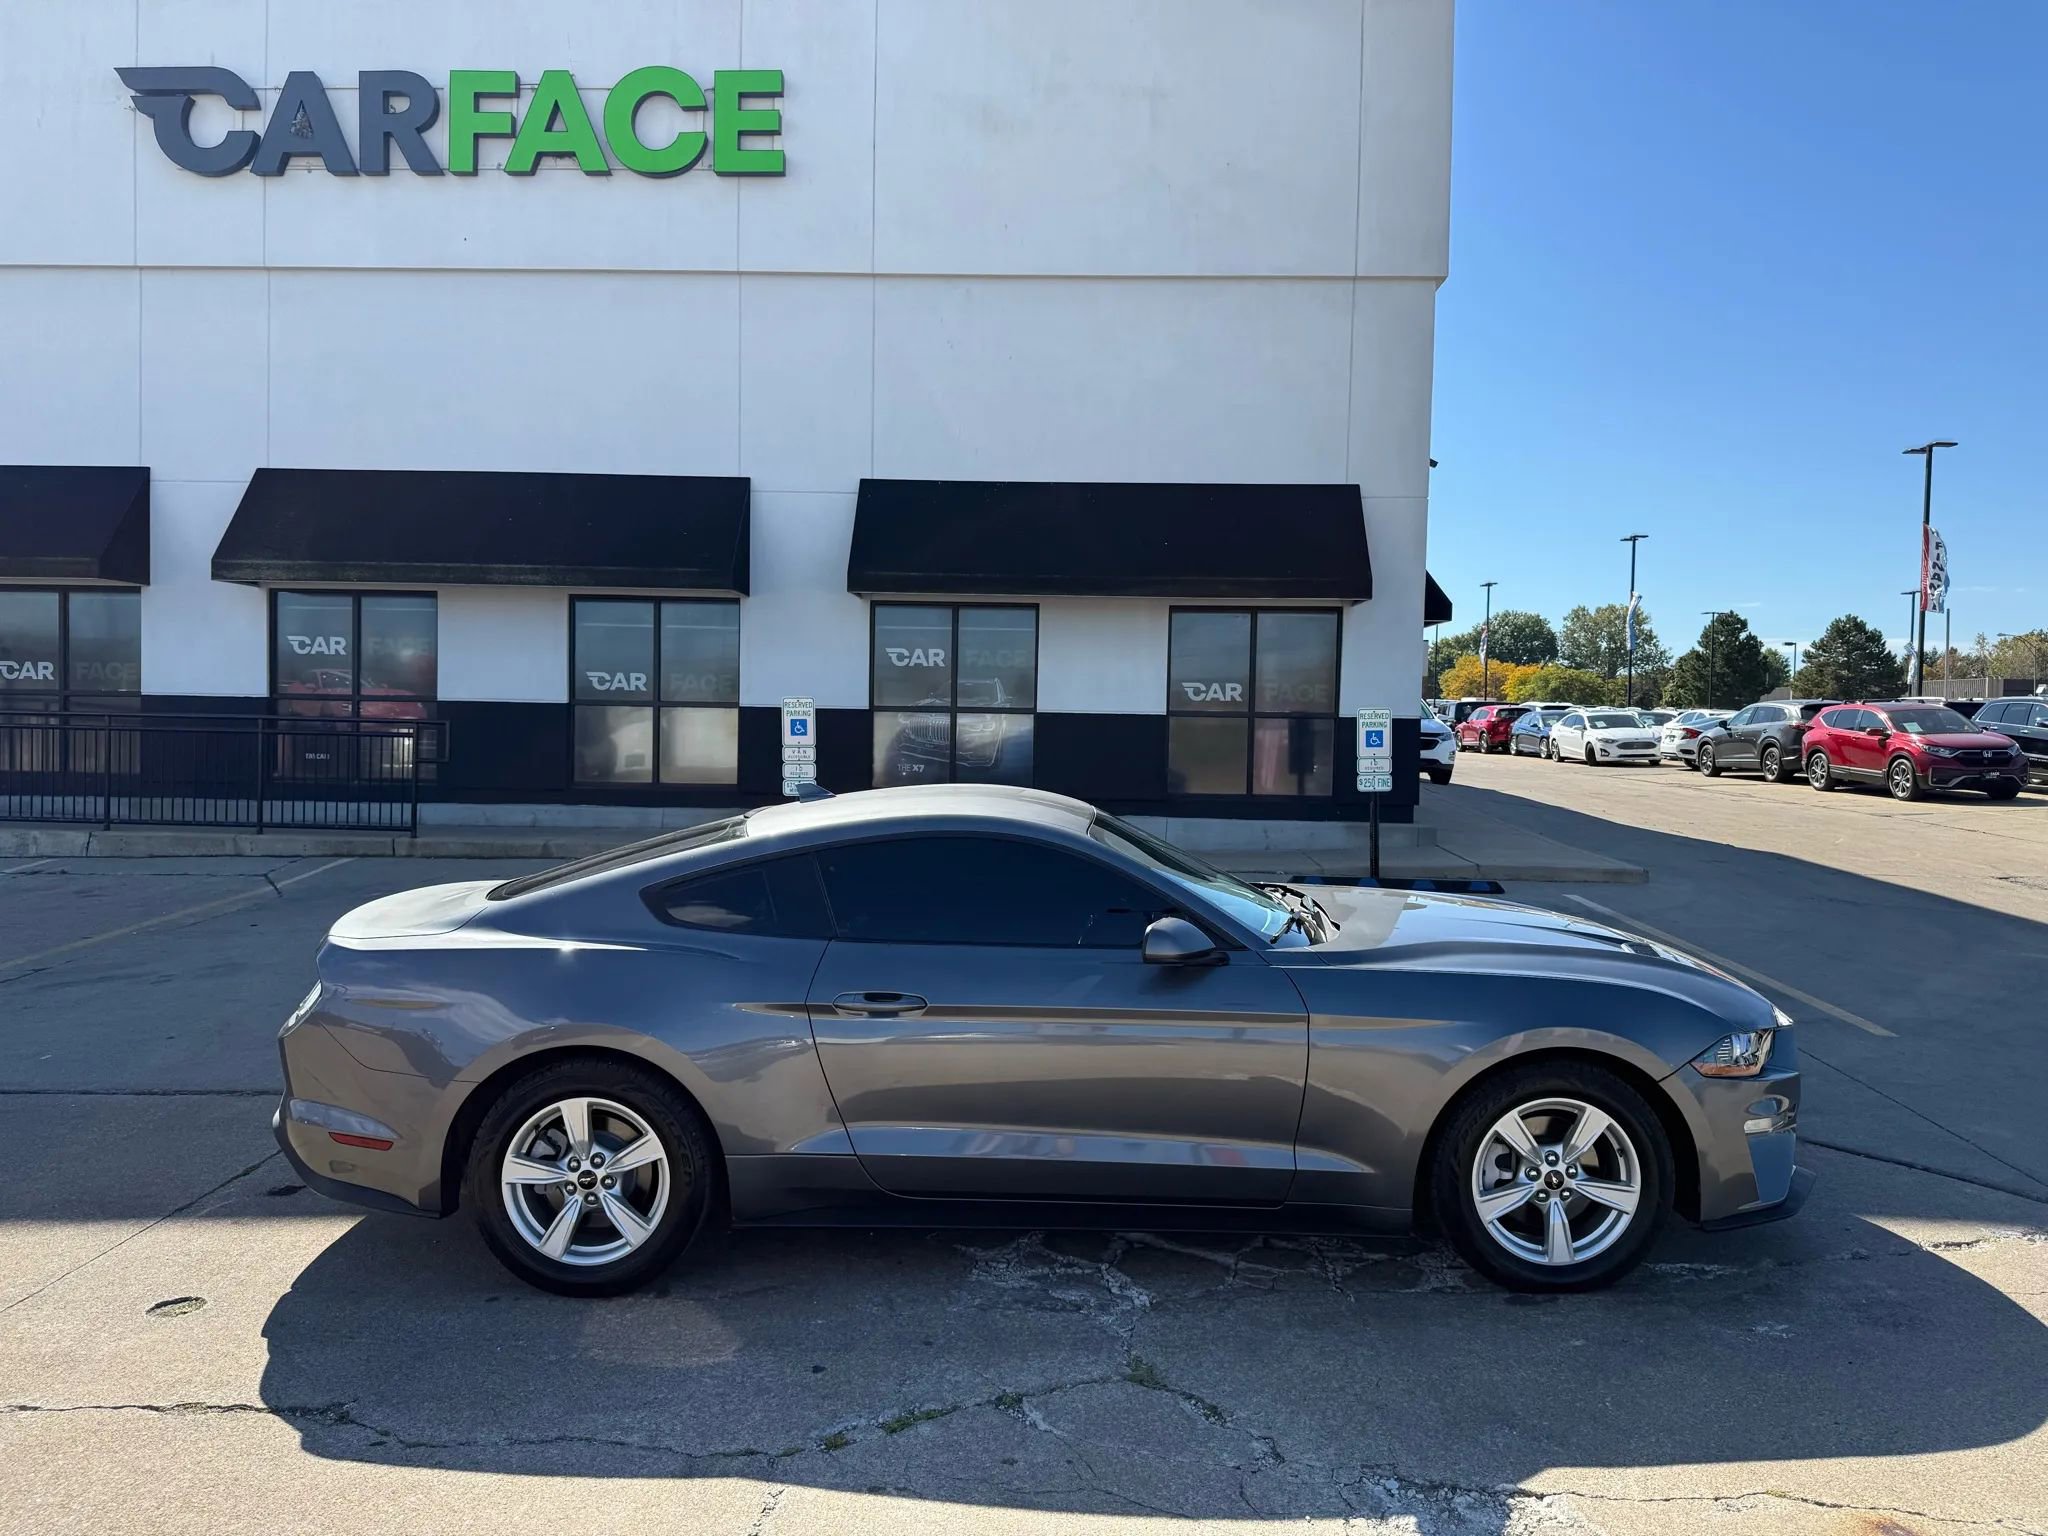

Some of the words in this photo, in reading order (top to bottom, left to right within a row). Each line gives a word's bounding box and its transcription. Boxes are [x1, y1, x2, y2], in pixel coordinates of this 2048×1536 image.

[114, 65, 786, 178] CARFACE
[286, 635, 347, 655] CAR
[885, 647, 947, 667] CAR
[0, 660, 55, 680] CAR
[586, 671, 648, 692] CAR
[1181, 681, 1244, 702] CAR
[784, 701, 812, 709] RESERVED
[1359, 712, 1390, 720] RESERVED
[1361, 721, 1388, 729] PARKING
[897, 763, 911, 772] THE
[912, 764, 925, 773] X7
[1359, 777, 1376, 788] $250
[1377, 777, 1391, 788] FINE
